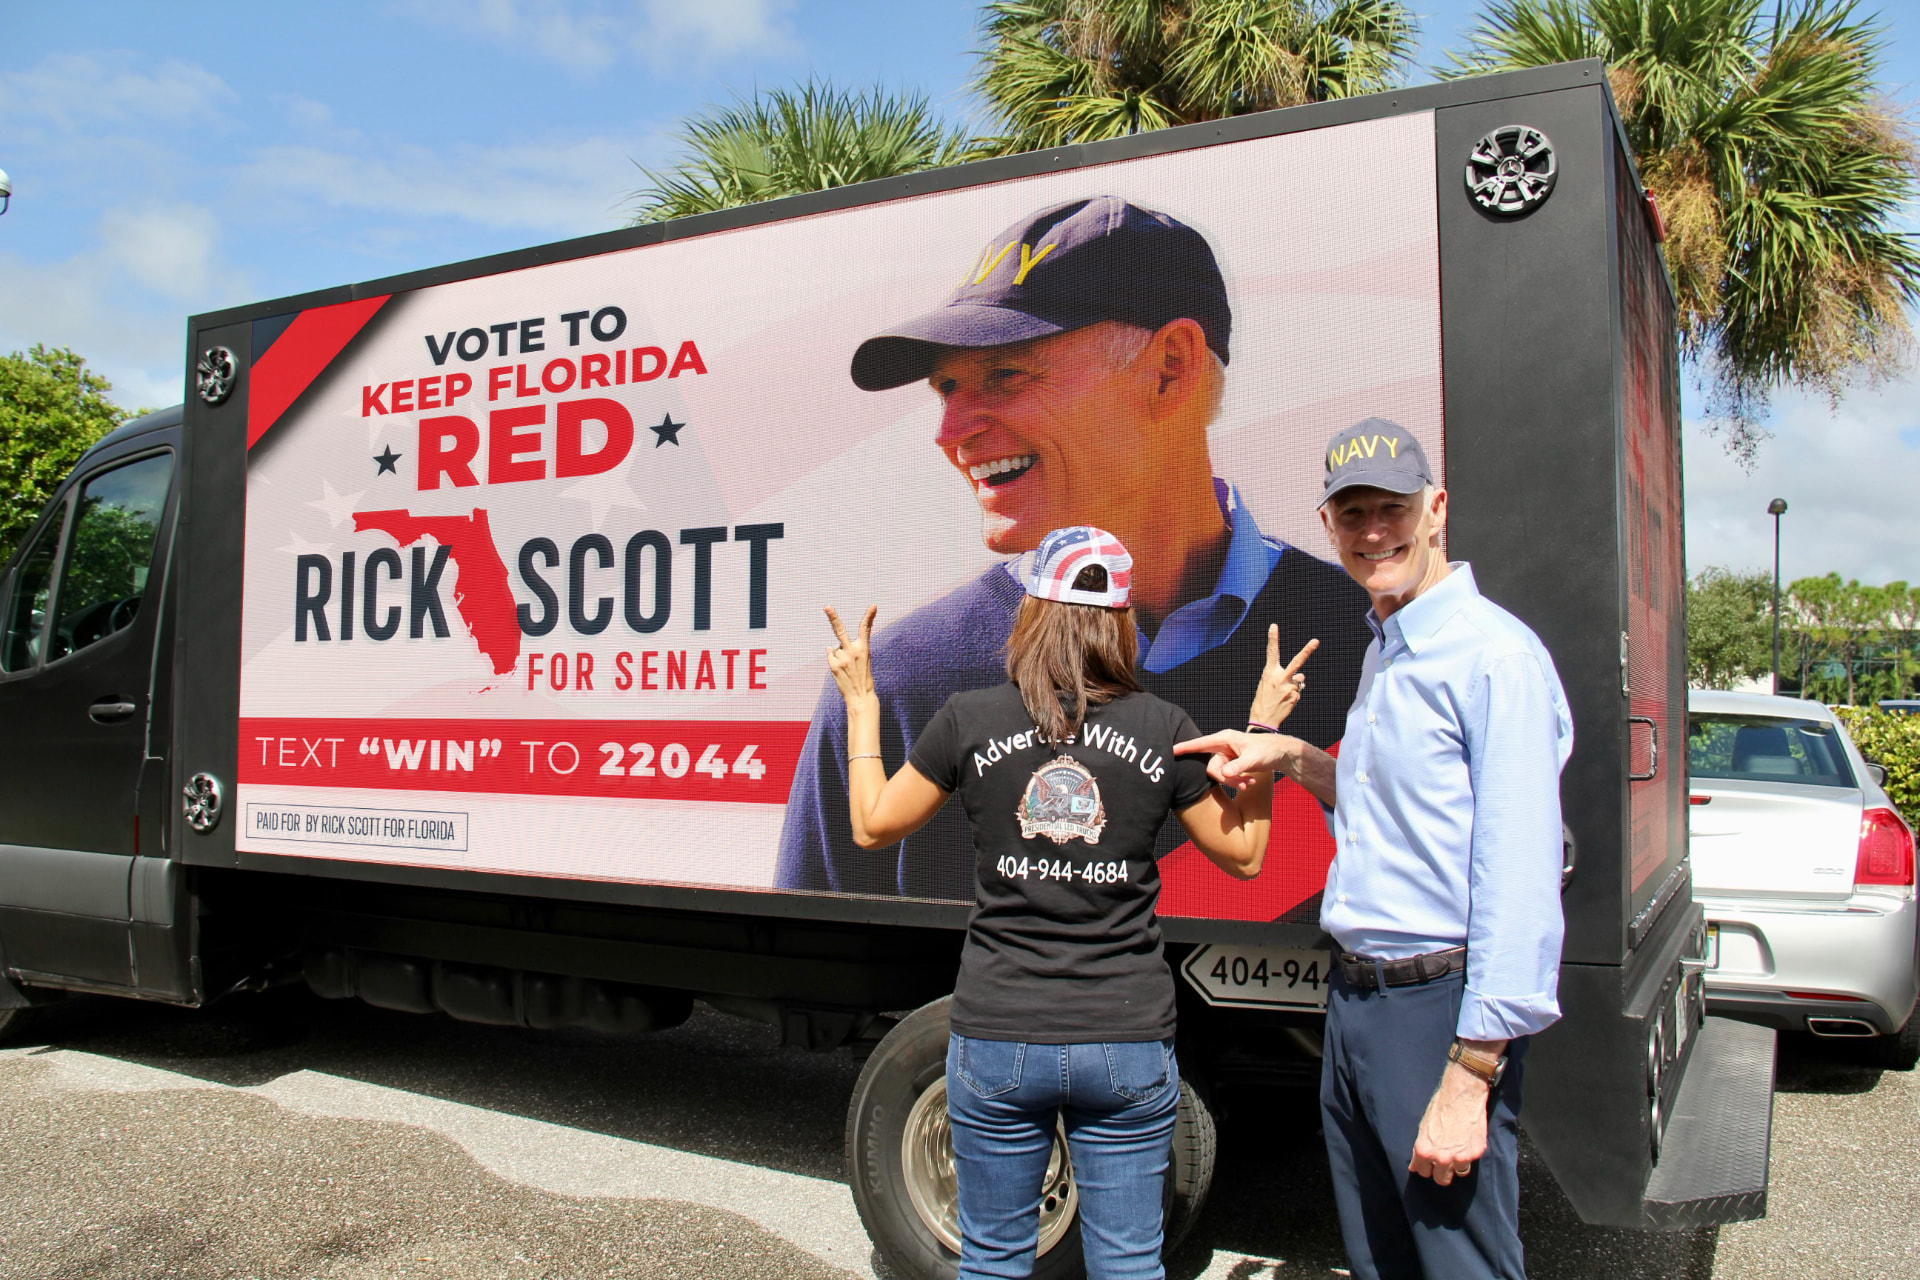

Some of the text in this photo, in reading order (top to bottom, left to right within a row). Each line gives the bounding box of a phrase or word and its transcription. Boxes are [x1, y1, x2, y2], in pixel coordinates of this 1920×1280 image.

[425, 306, 627, 366] VOTE TO
[361, 340, 708, 417] KEEP FLORIDA
[417, 397, 635, 491] RED
[1330, 434, 1399, 472] NAVY
[294, 522, 785, 642] RICK SCOTT
[528, 648, 767, 690] FOR SENATE
[255, 736, 345, 768] TEXT
[520, 741, 580, 774] TO
[598, 742, 766, 780] 22044
[1083, 722, 1138, 764] With
[1139, 748, 1165, 783] Us
[256, 811, 455, 841] PAID FOR BY RICK SCOTT FOR FLORIDA
[1024, 821, 1063, 833] PRESIDENTIAL
[1076, 825, 1097, 839] TRUCKS
[996, 854, 1129, 883] 404-944-4684
[867, 1104, 884, 1194] KUMHO
